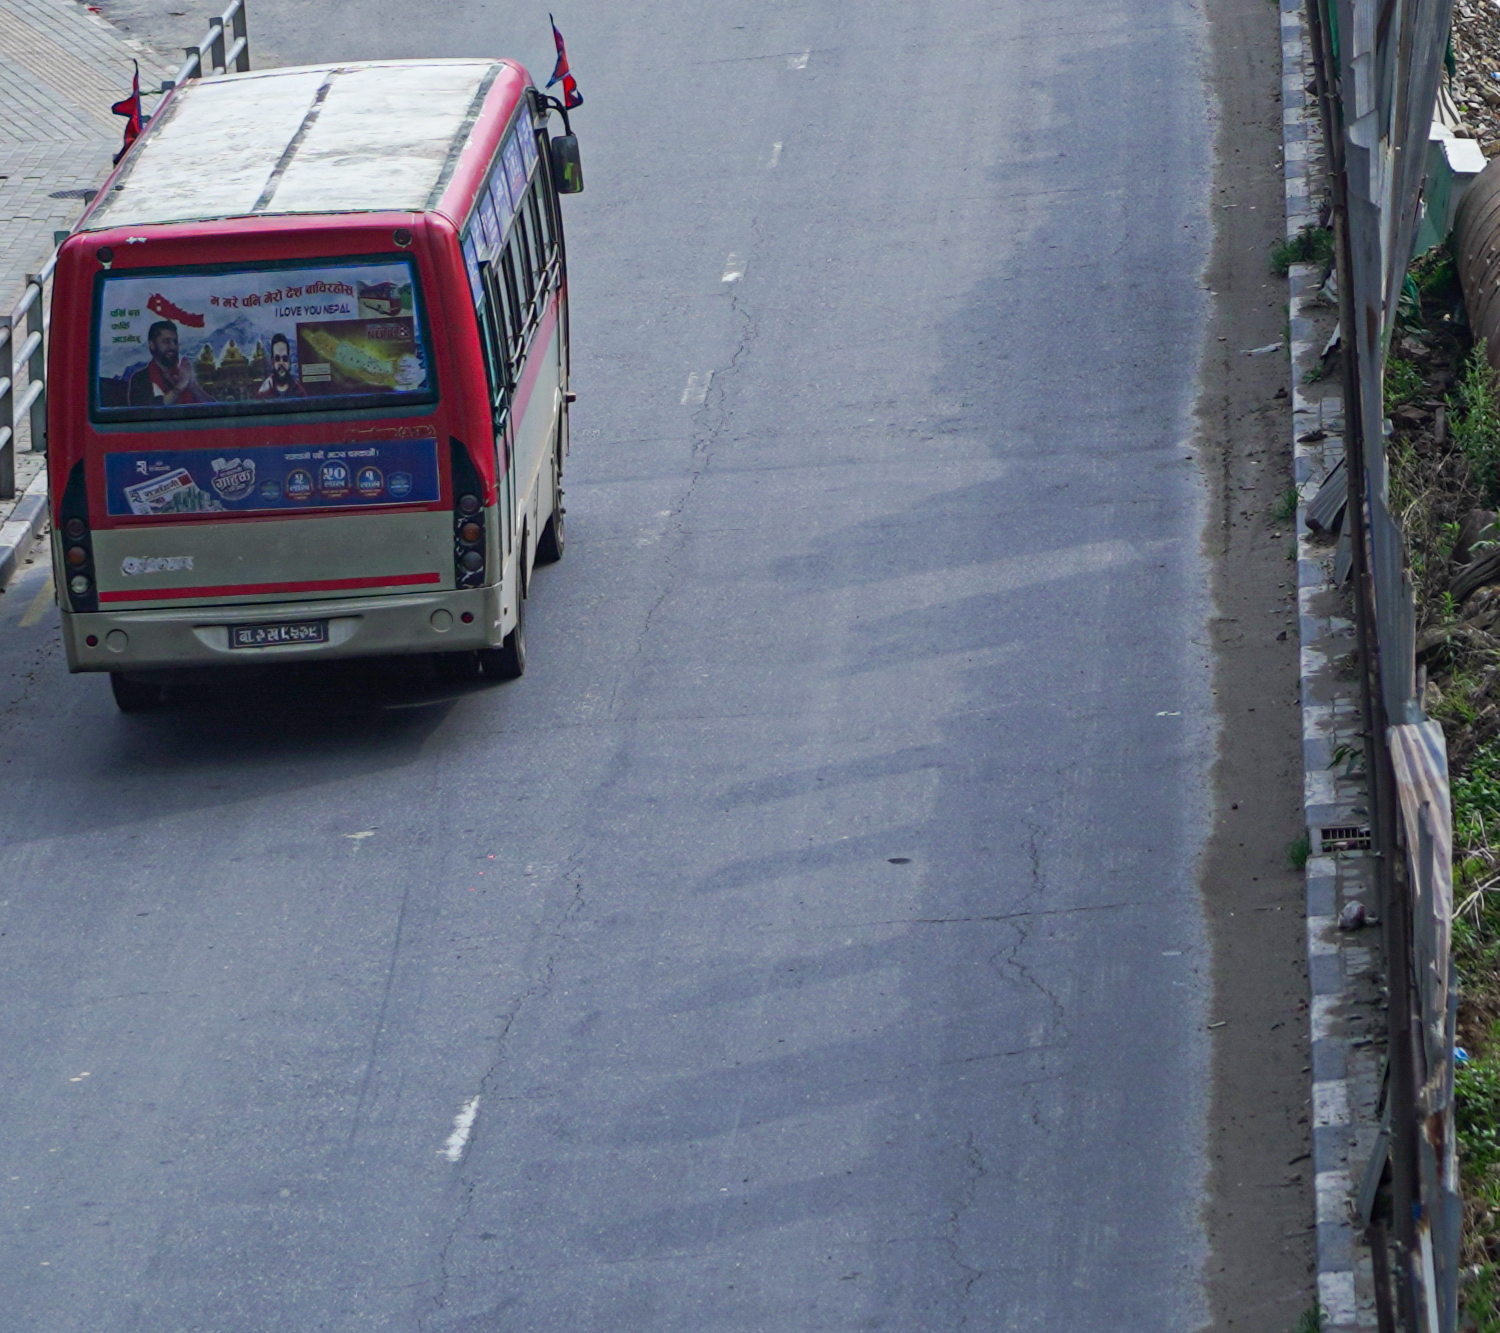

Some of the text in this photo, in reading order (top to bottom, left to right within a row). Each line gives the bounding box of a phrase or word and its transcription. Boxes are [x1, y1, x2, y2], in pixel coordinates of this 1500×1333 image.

[222, 296, 239, 308] मरे
[242, 294, 261, 307] पनि
[264, 289, 283, 304] मेरो
[286, 286, 303, 298] देश
[279, 306, 302, 317] LOVE
[305, 305, 322, 315] YOU
[323, 304, 350, 315] NEPAL
[322, 467, 346, 480] ५०
